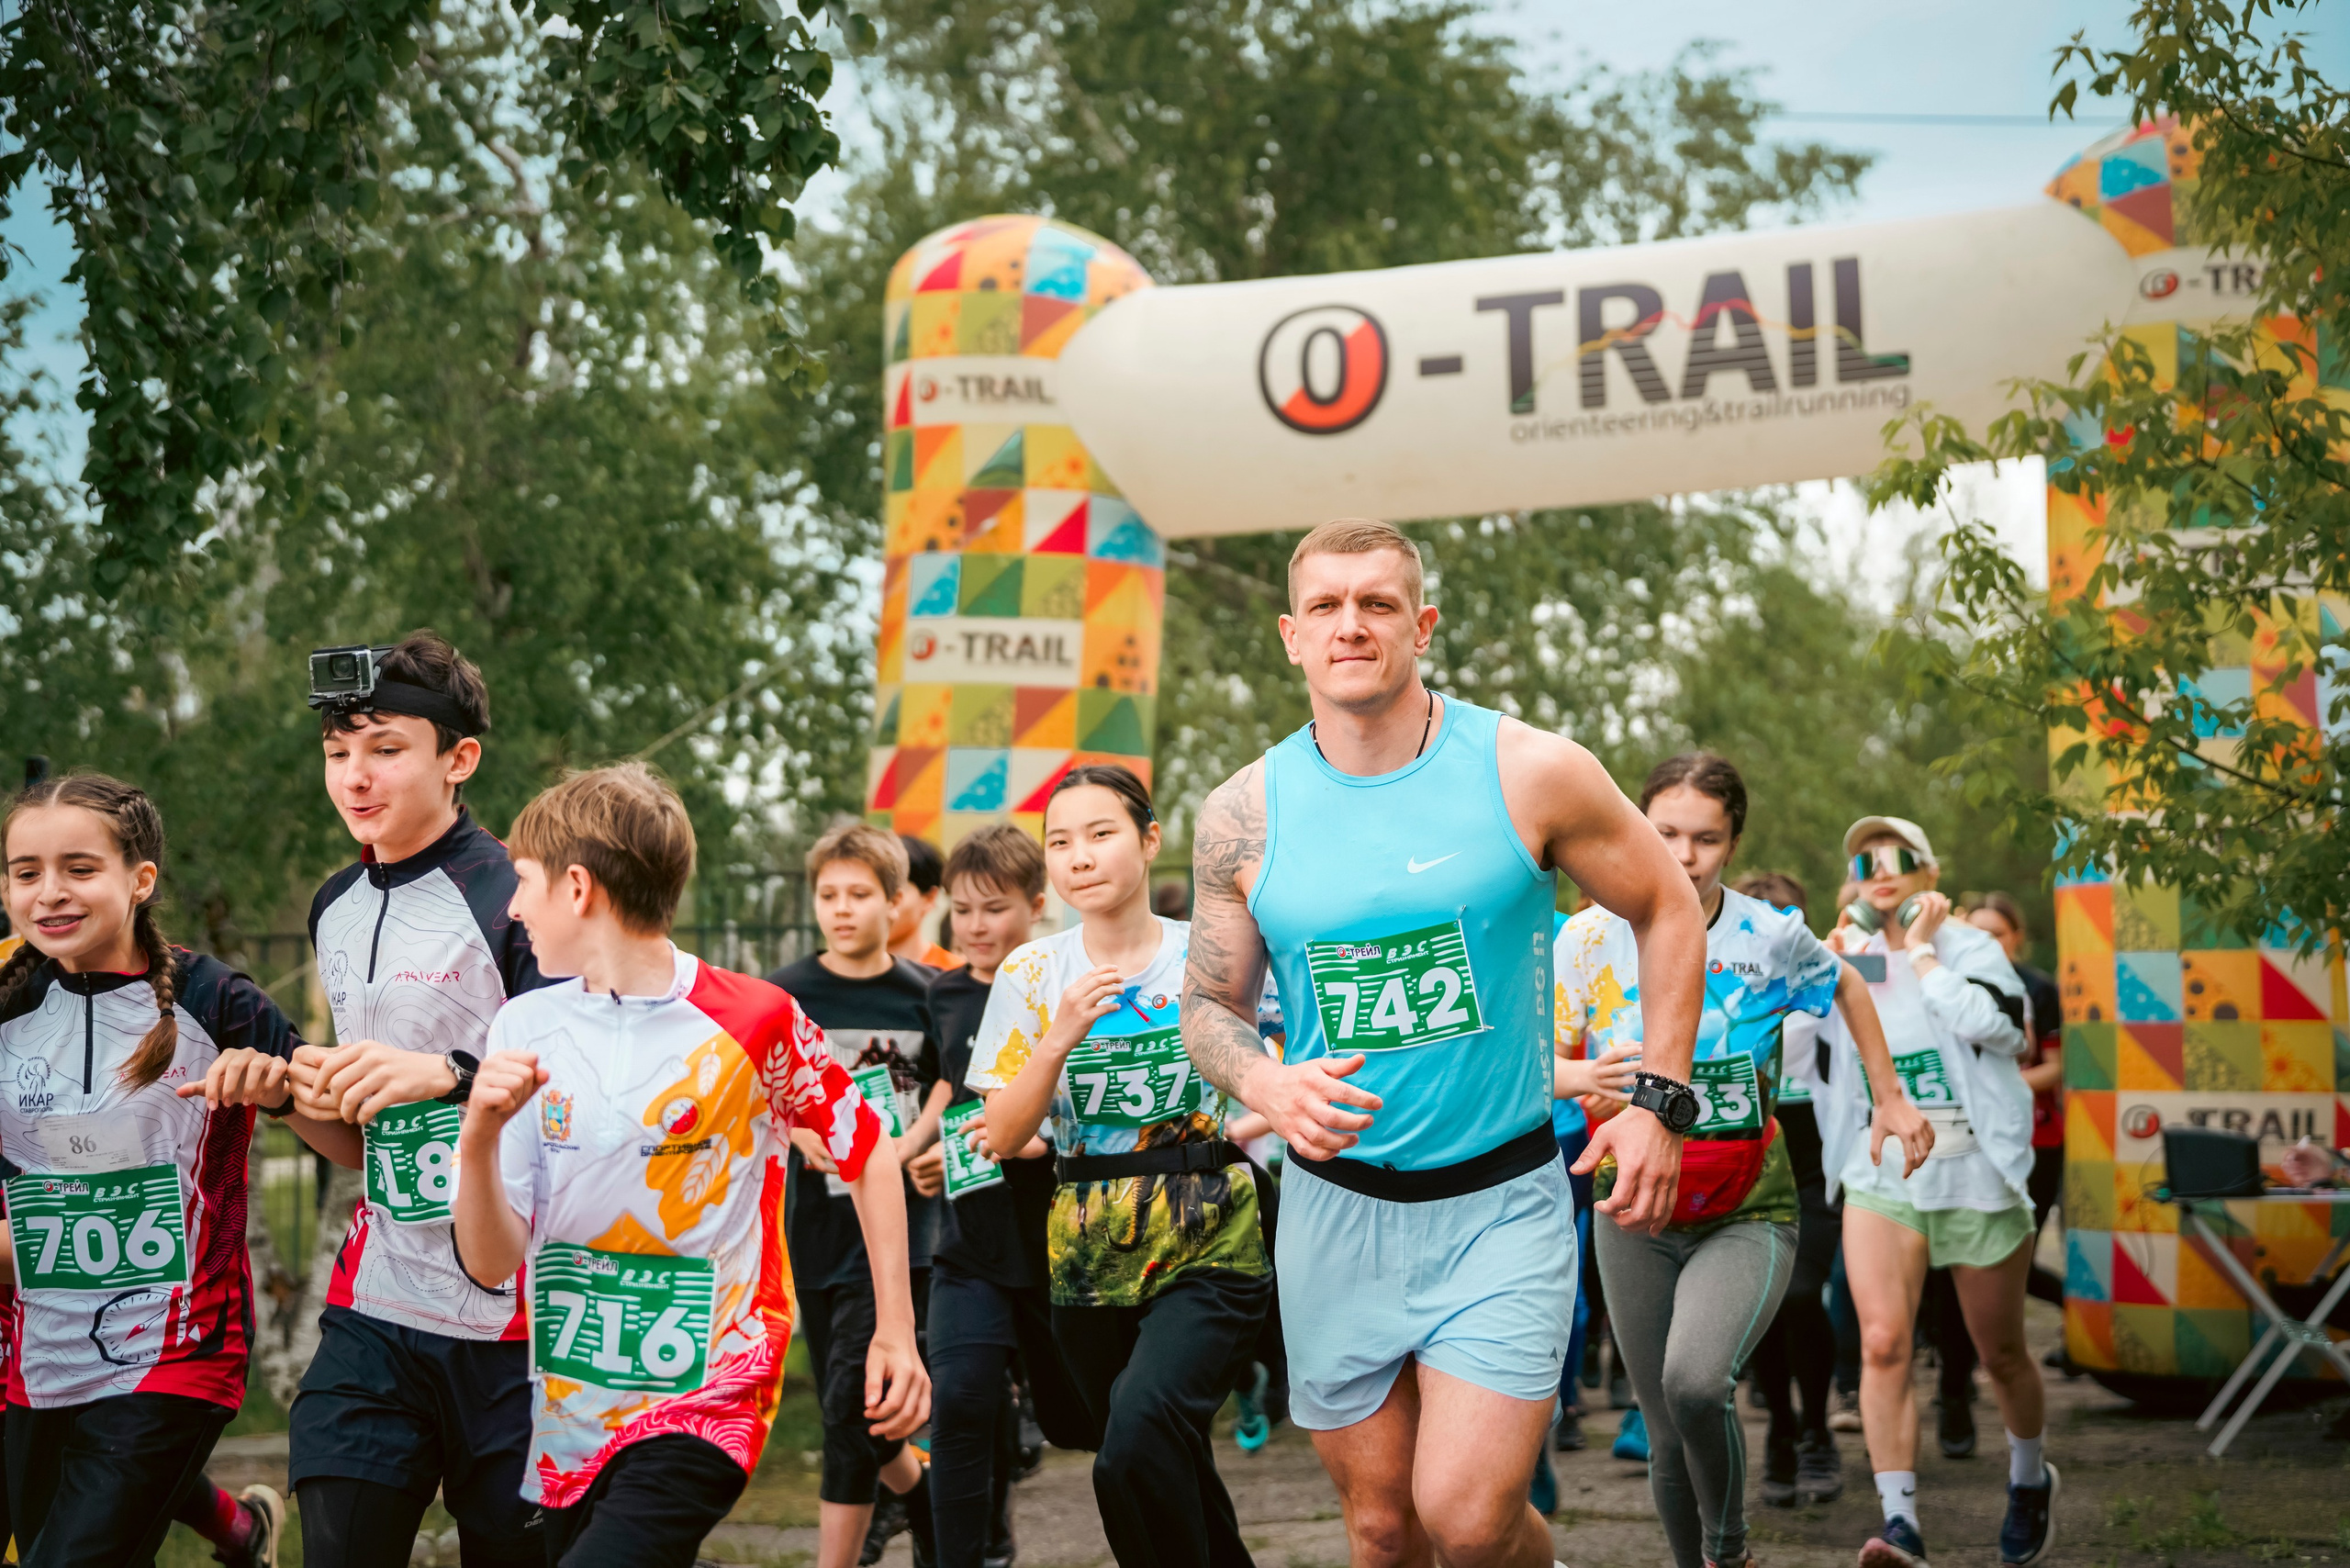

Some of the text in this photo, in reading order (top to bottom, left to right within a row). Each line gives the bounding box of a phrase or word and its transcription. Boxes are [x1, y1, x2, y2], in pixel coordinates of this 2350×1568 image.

[1510, 381, 1912, 443] orienteering&trailrunning
[1324, 967, 1469, 1039] 742
[19, 1092, 54, 1107] ИКАР
[1075, 1060, 1192, 1117] 737
[70, 1133, 97, 1155] 86
[43, 1178, 90, 1193] О-ТРЕЙЛ
[26, 1209, 176, 1275] 706
[549, 1290, 696, 1377] 716
